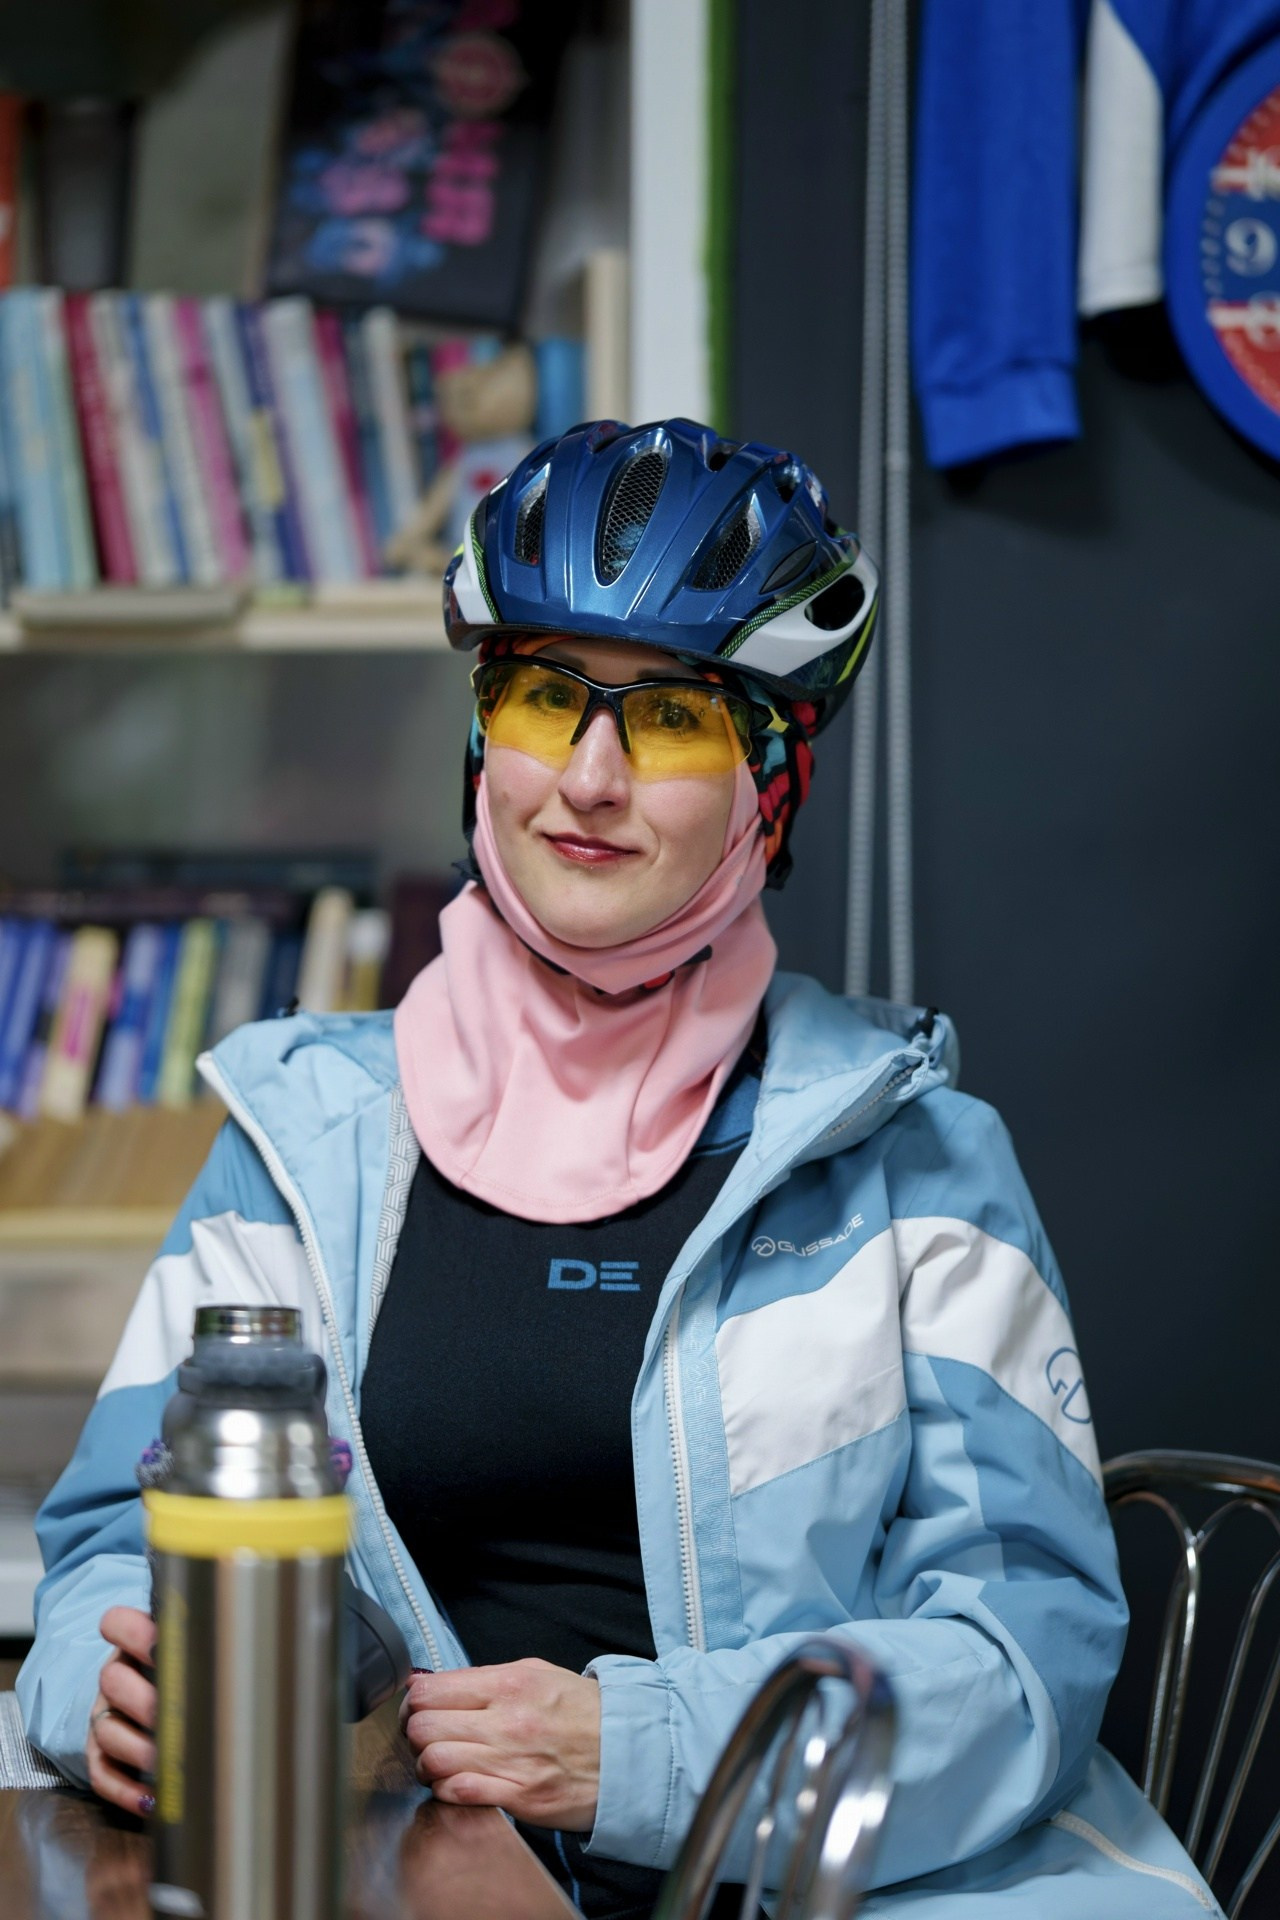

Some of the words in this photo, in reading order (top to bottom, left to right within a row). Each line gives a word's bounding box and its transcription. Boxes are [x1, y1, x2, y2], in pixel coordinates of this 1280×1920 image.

[1225, 217, 1278, 277] 9
[777, 1213, 865, 1257] GLISSADE
[547, 1258, 641, 1291] DE
